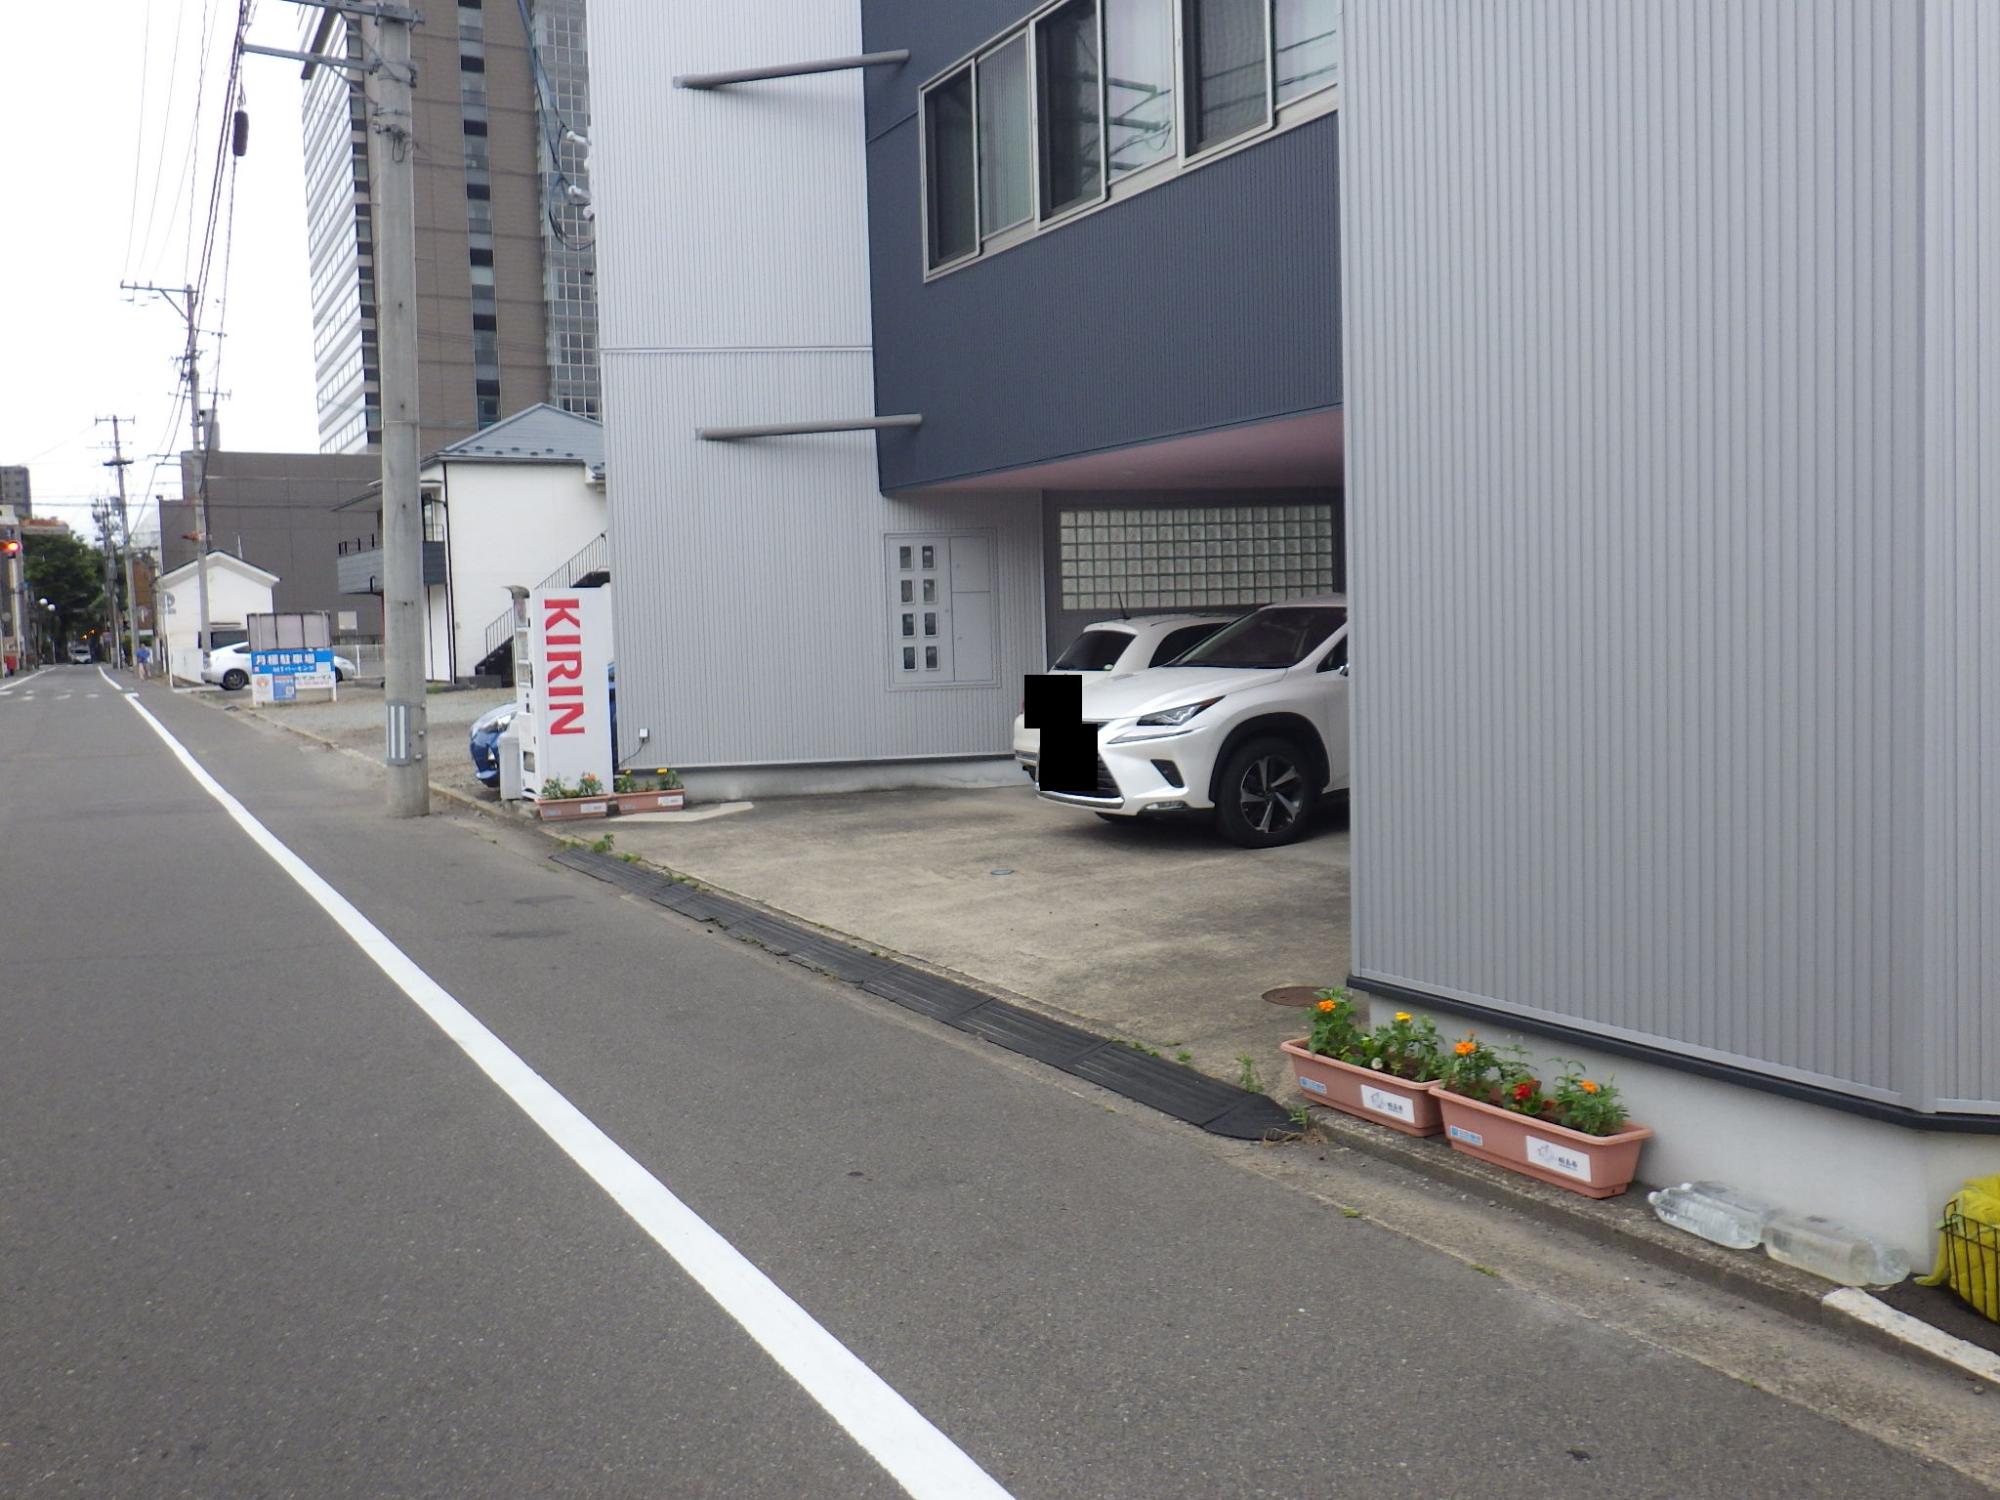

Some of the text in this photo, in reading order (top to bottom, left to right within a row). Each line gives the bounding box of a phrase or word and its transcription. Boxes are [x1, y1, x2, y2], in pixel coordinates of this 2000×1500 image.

[256, 654, 315, 665] 月極駐車場
[544, 598, 586, 736] KIRIN
